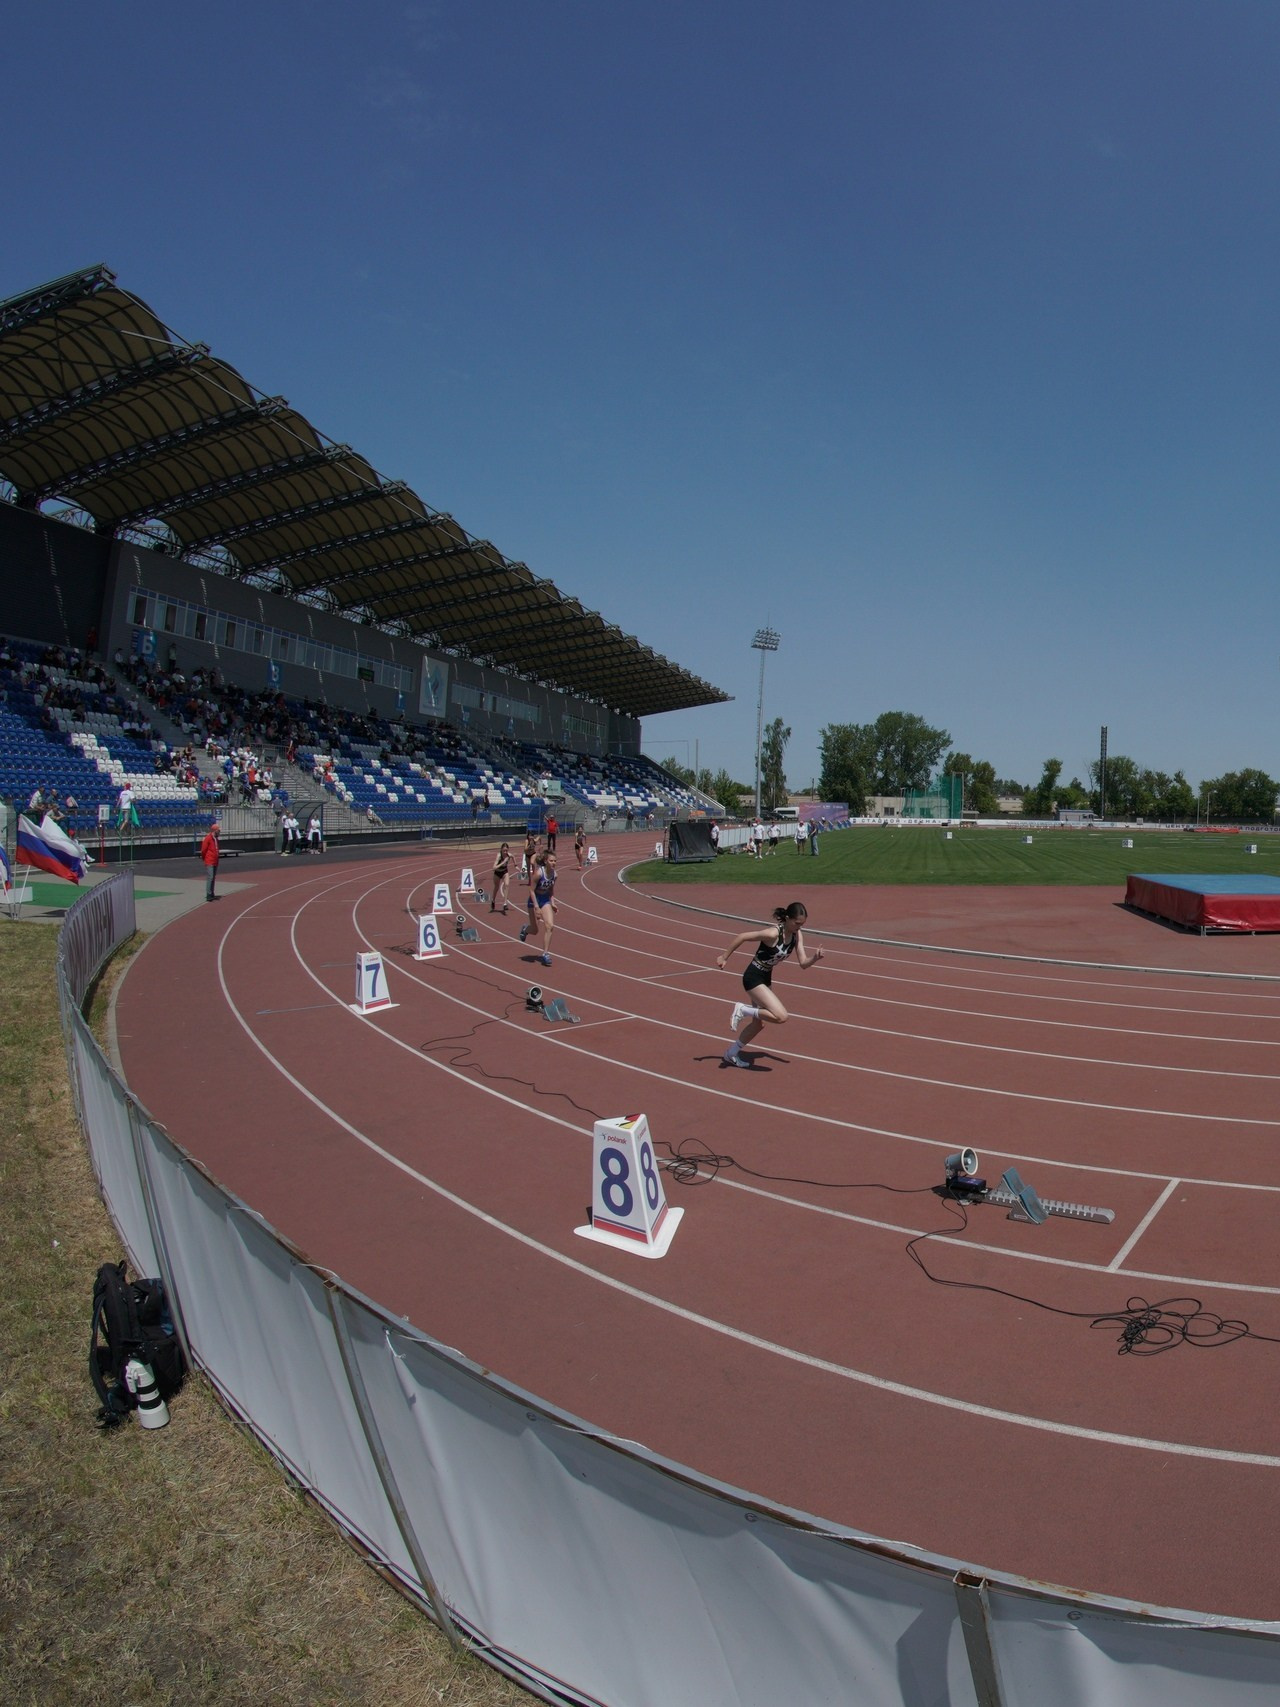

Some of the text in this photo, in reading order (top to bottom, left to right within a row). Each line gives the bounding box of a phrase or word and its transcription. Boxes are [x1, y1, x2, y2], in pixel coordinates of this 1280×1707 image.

[589, 849, 597, 860] 2
[463, 873, 473, 888] 4
[436, 889, 448, 908] 5
[423, 923, 437, 949] 6
[365, 963, 381, 998] 7
[607, 1134, 627, 1144] polanik
[600, 1147, 634, 1217] 8
[640, 1141, 659, 1211] 8
